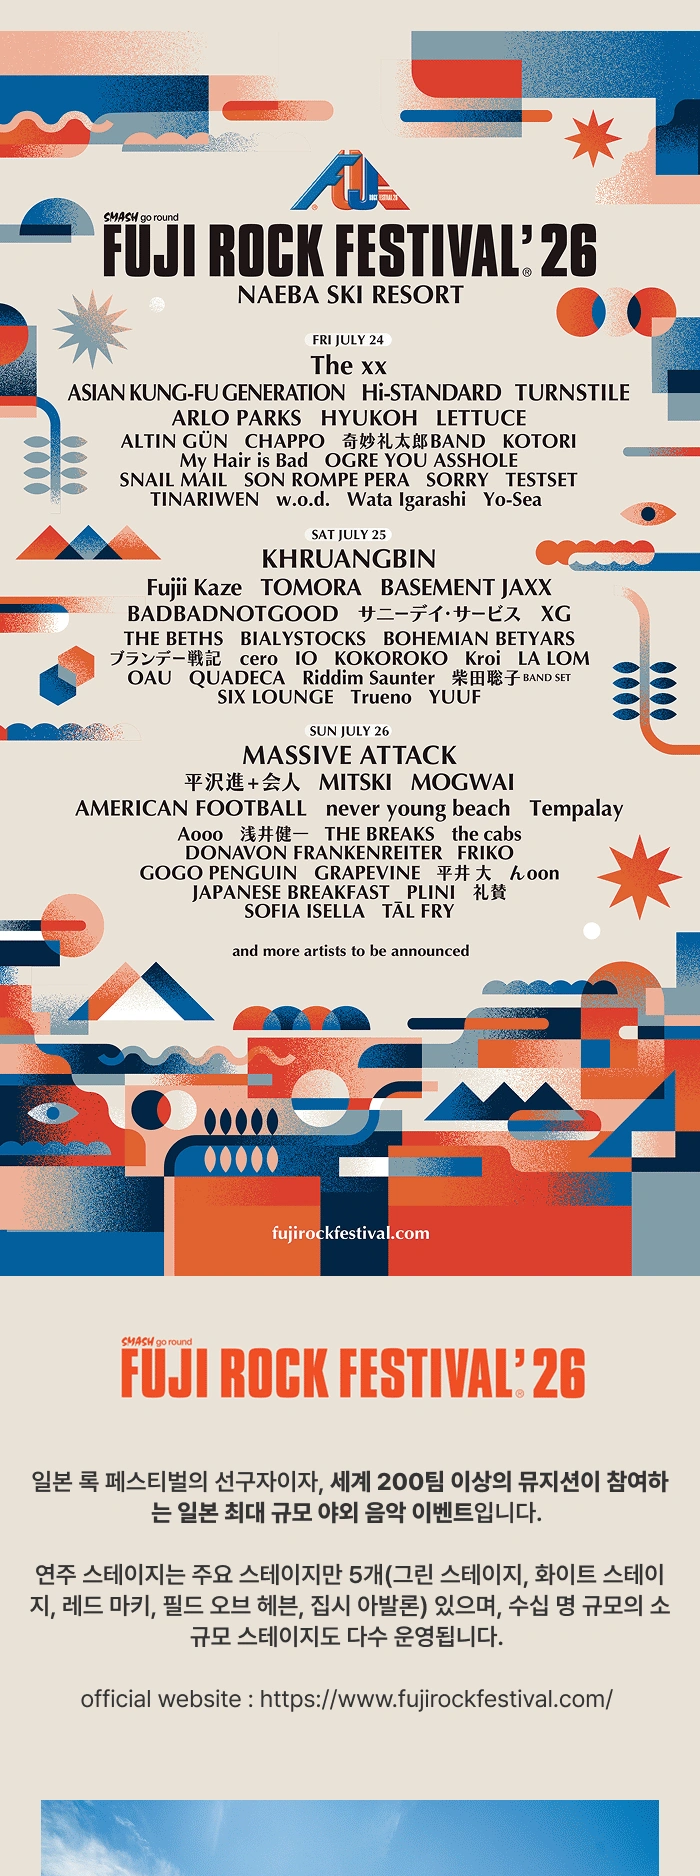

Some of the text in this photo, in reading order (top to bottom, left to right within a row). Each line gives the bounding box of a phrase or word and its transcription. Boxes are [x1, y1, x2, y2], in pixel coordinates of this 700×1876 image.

[103, 212, 139, 223] SMASH
[153, 213, 179, 222] round
[104, 224, 195, 277] FUJI
[209, 224, 324, 277] ROCK
[238, 285, 464, 304] NAEBA SKI RESORT
[313, 335, 384, 346] FRI JULY 24
[310, 354, 387, 375] The xx
[68, 382, 629, 401] ASIAN KUNG-FU GENERATION Hi-STANDARD TURNSTILE
[121, 430, 576, 450] ALTIN GÜN CHAPPO 奇妙礼太郎BAND KOTORI
[263, 549, 435, 568] KHRUANGBIN
[110, 650, 589, 667] ブランデー戦記 cero IO KOKOROKO Kroi LA LOM
[310, 726, 389, 737] SUN JULY 26
[243, 745, 457, 765] MASSIVE ATTACK
[184, 772, 513, 792] 平沢進+会人 MITSKI MOGWAI
[232, 944, 469, 957] and more artists to be announced
[272, 1225, 430, 1243] fujirockfestival.com
[121, 1336, 193, 1348] SMASH go round
[121, 1348, 207, 1398] FUJI
[221, 1348, 329, 1398] ROCK
[32, 1470, 669, 1495] 일본 록 페스티벌의 선구자이자, 세계 200팀 이상의 뮤지션이 참여하
[81, 1689, 613, 1712] official website : https://www.fujirockfestival.com/
